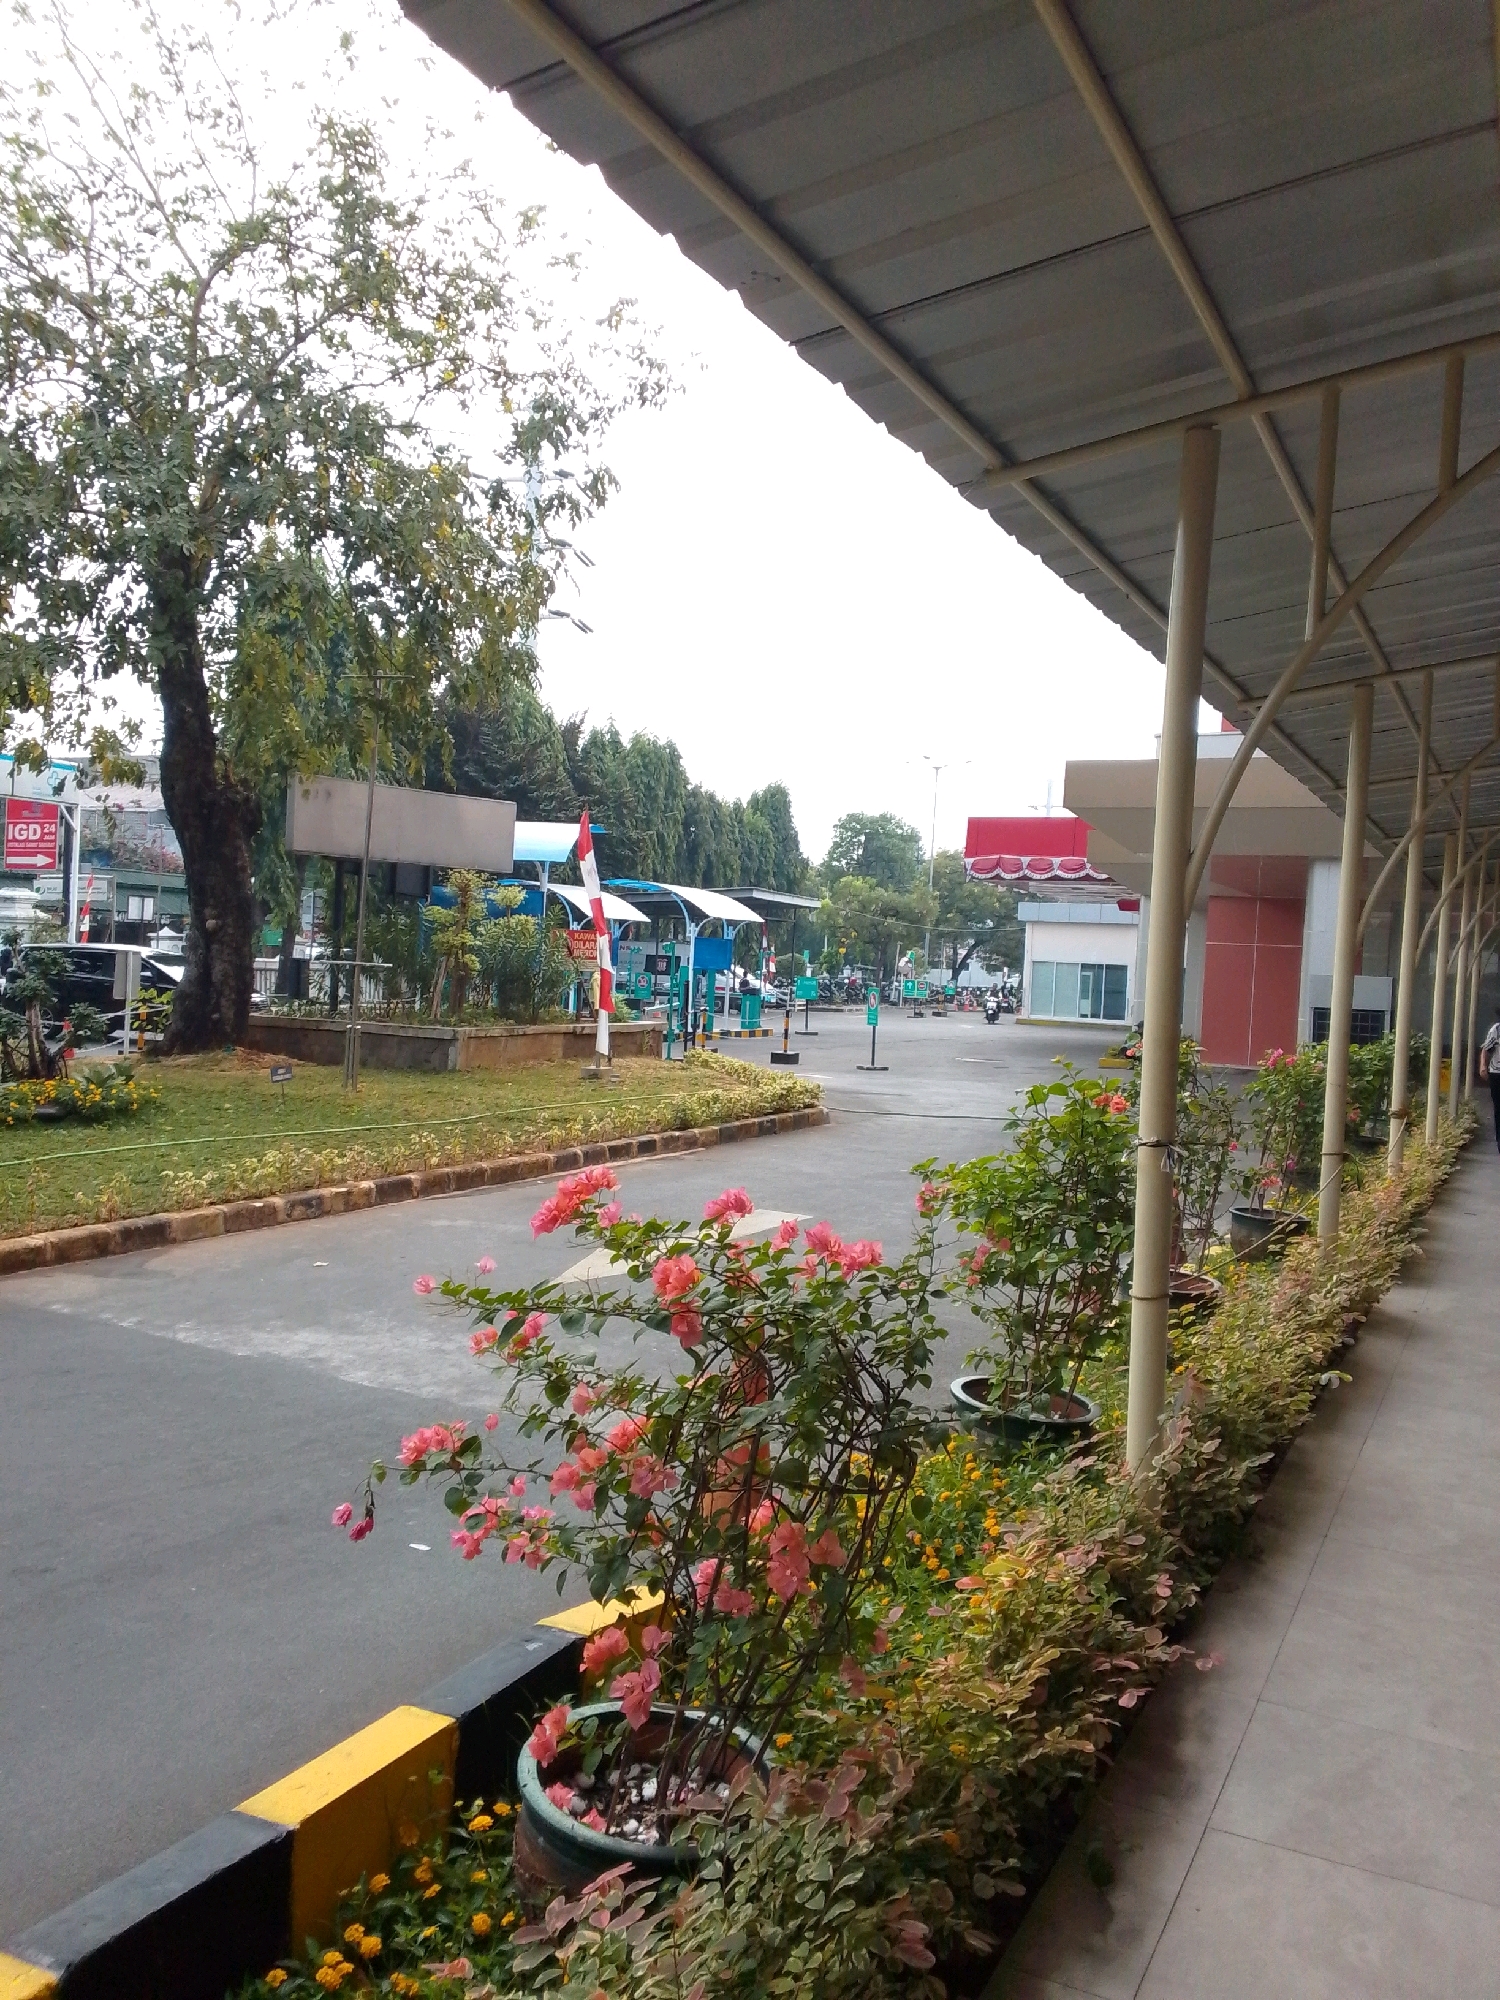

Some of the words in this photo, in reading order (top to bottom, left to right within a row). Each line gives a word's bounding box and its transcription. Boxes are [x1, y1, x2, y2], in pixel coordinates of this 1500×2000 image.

[8, 823, 41, 840] IGD
[43, 823, 56, 833] 24
[573, 940, 597, 950] DILAR
